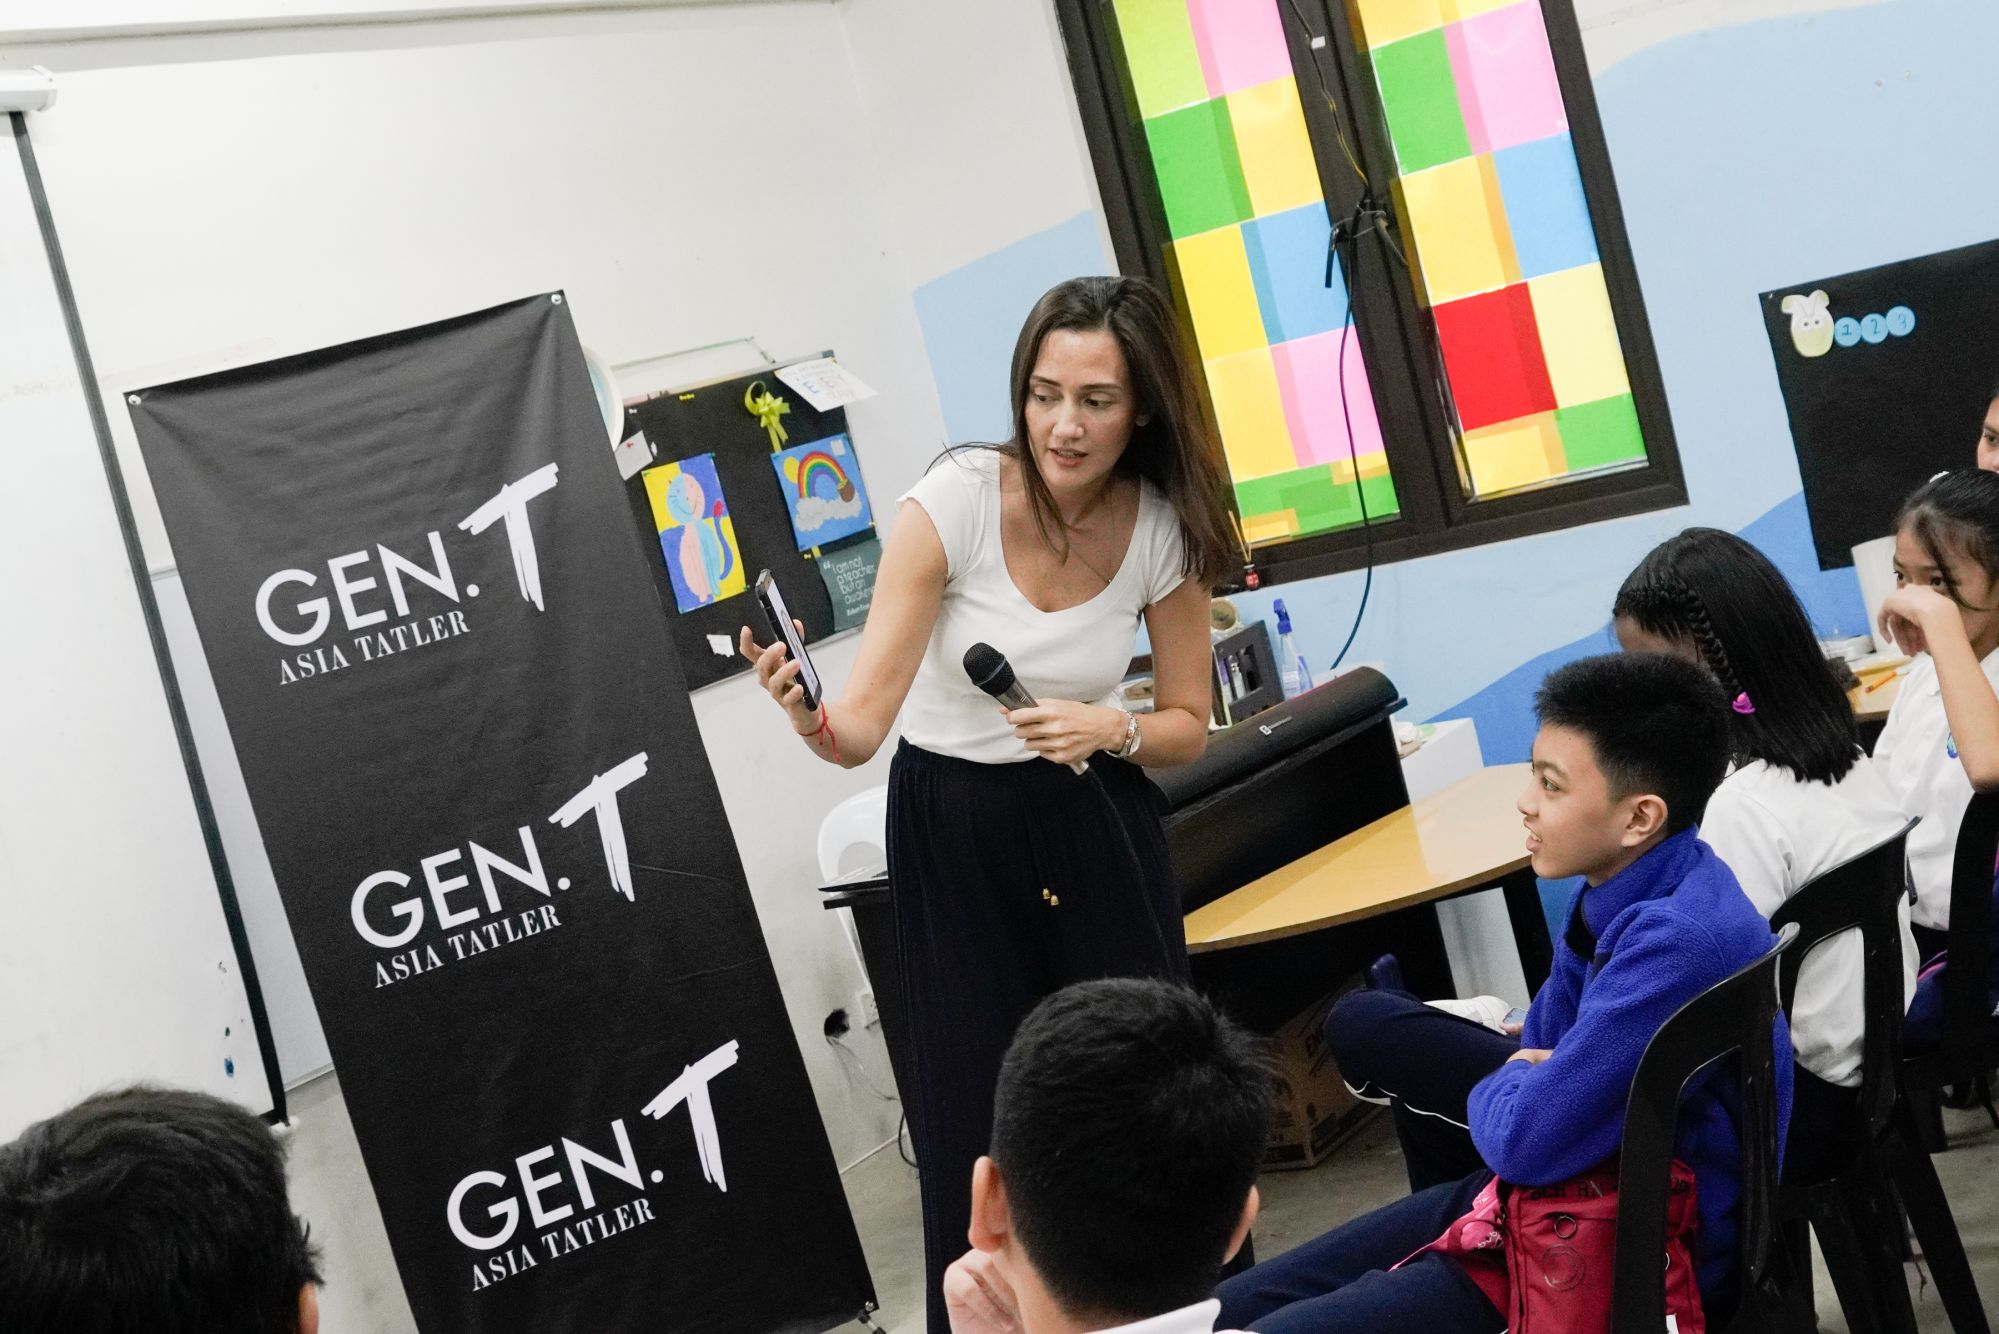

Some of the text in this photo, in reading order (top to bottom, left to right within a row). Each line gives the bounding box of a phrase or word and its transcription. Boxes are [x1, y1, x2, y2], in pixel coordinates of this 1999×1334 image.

[279, 610, 471, 686] ASIA TATLER
[375, 904, 562, 989] ASIA TATLER
[472, 1198, 656, 1292] ASIA TATLER
